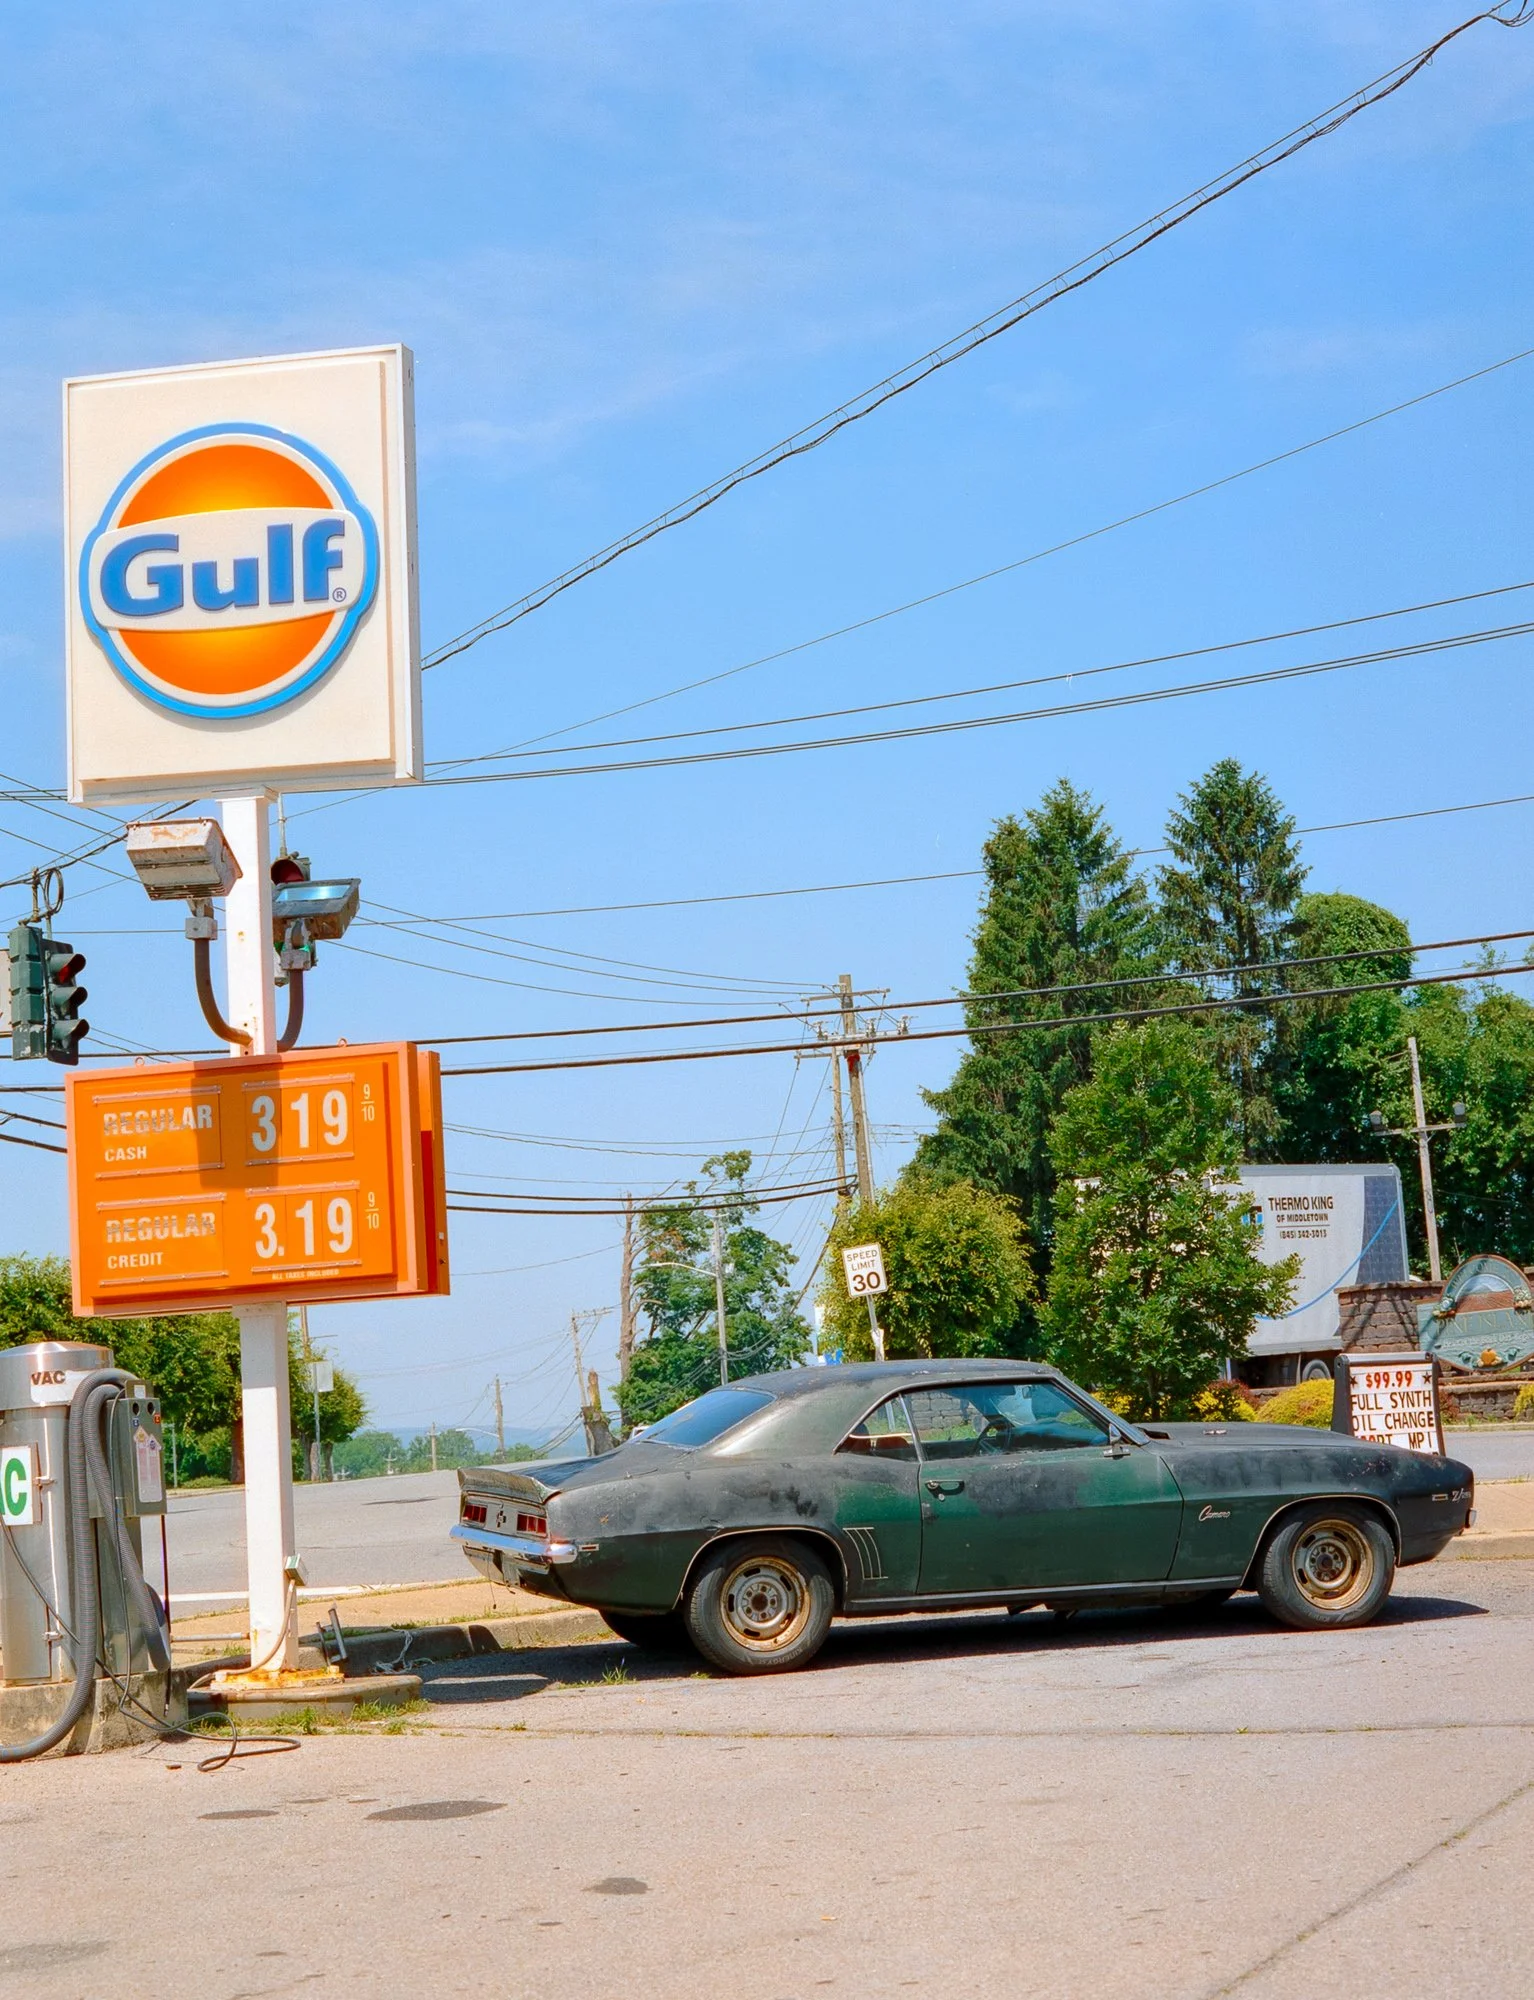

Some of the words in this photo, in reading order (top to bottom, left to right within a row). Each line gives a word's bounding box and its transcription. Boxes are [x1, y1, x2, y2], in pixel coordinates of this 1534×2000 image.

[100, 518, 346, 617] Gulf
[103, 1104, 213, 1136] REGULAR
[104, 1145, 147, 1162] CASH
[1268, 1196, 1310, 1211] THERMO
[1311, 1195, 1333, 1210] KING
[1276, 1214, 1285, 1222] OF
[1287, 1213, 1328, 1222] MIDDLETOWN
[106, 1212, 216, 1243] REGULAR
[107, 1251, 163, 1269] CREDIT
[847, 1250, 877, 1261] SPEED
[852, 1260, 875, 1271] LIMIT
[852, 1271, 881, 1292] 30
[30, 1370, 66, 1385] VAC
[1365, 1371, 1413, 1388] $99.99
[1350, 1393, 1383, 1411] FULL
[1390, 1391, 1431, 1409] SYNTH
[1352, 1414, 1376, 1431] OIL
[1385, 1411, 1434, 1430] CHANGE
[0, 1457, 28, 1516] C
